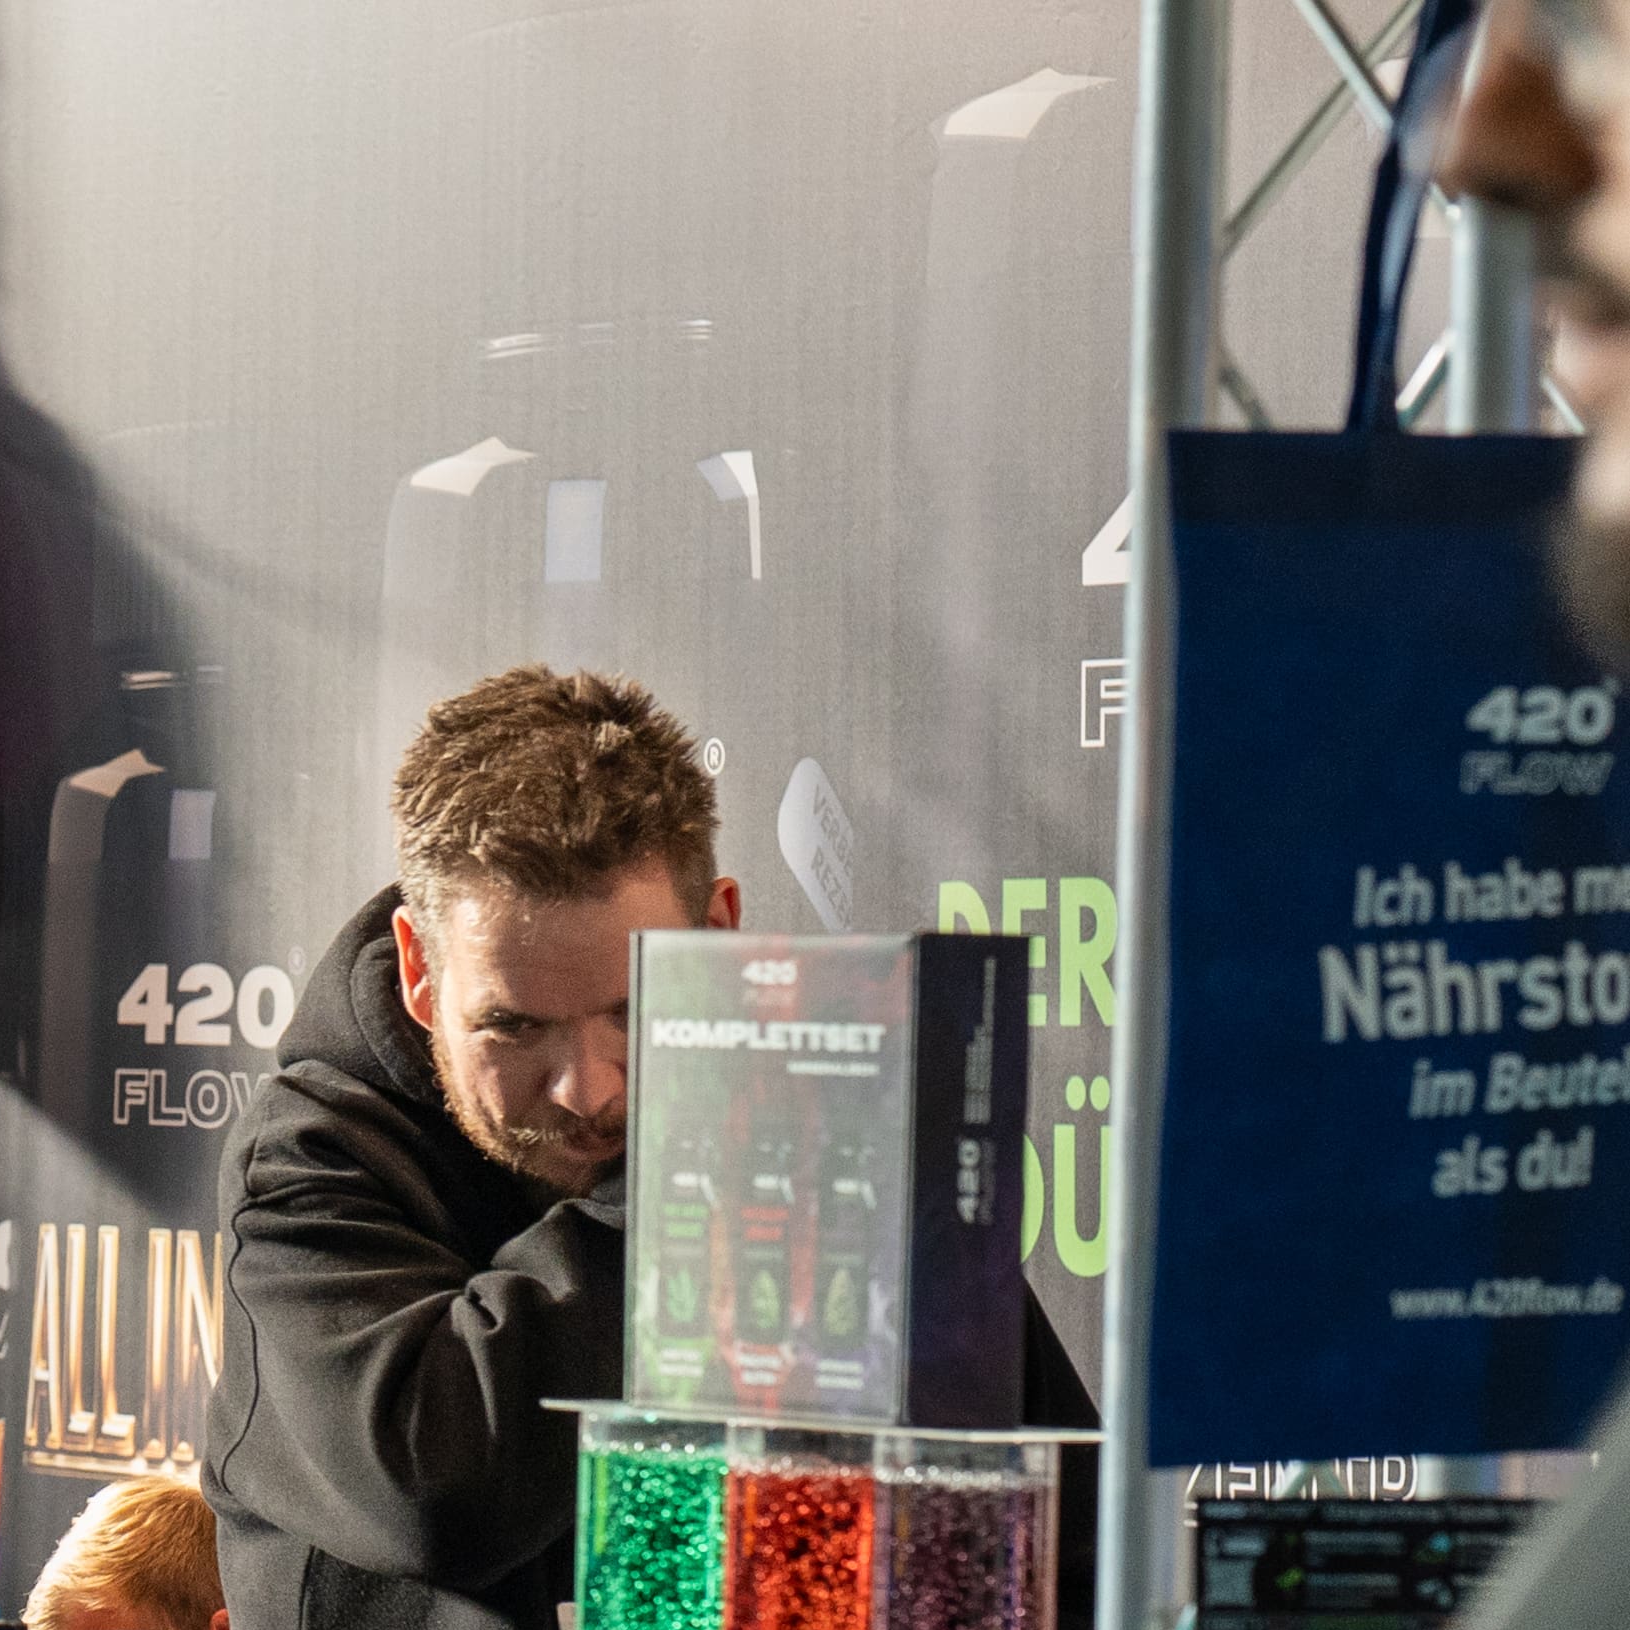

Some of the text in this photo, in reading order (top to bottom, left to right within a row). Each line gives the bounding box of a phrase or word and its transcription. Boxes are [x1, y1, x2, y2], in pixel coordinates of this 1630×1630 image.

[1465, 684, 1613, 745] 420
[1459, 750, 1614, 797] FLOW
[1354, 862, 1433, 928] Ich
[1443, 857, 1565, 925] habe
[117, 963, 296, 1050] 420
[651, 1018, 886, 1053] KOMPLETTSET
[1408, 1056, 1478, 1121] im
[1430, 1130, 1510, 1200] als
[24, 1222, 138, 1461] ALL
